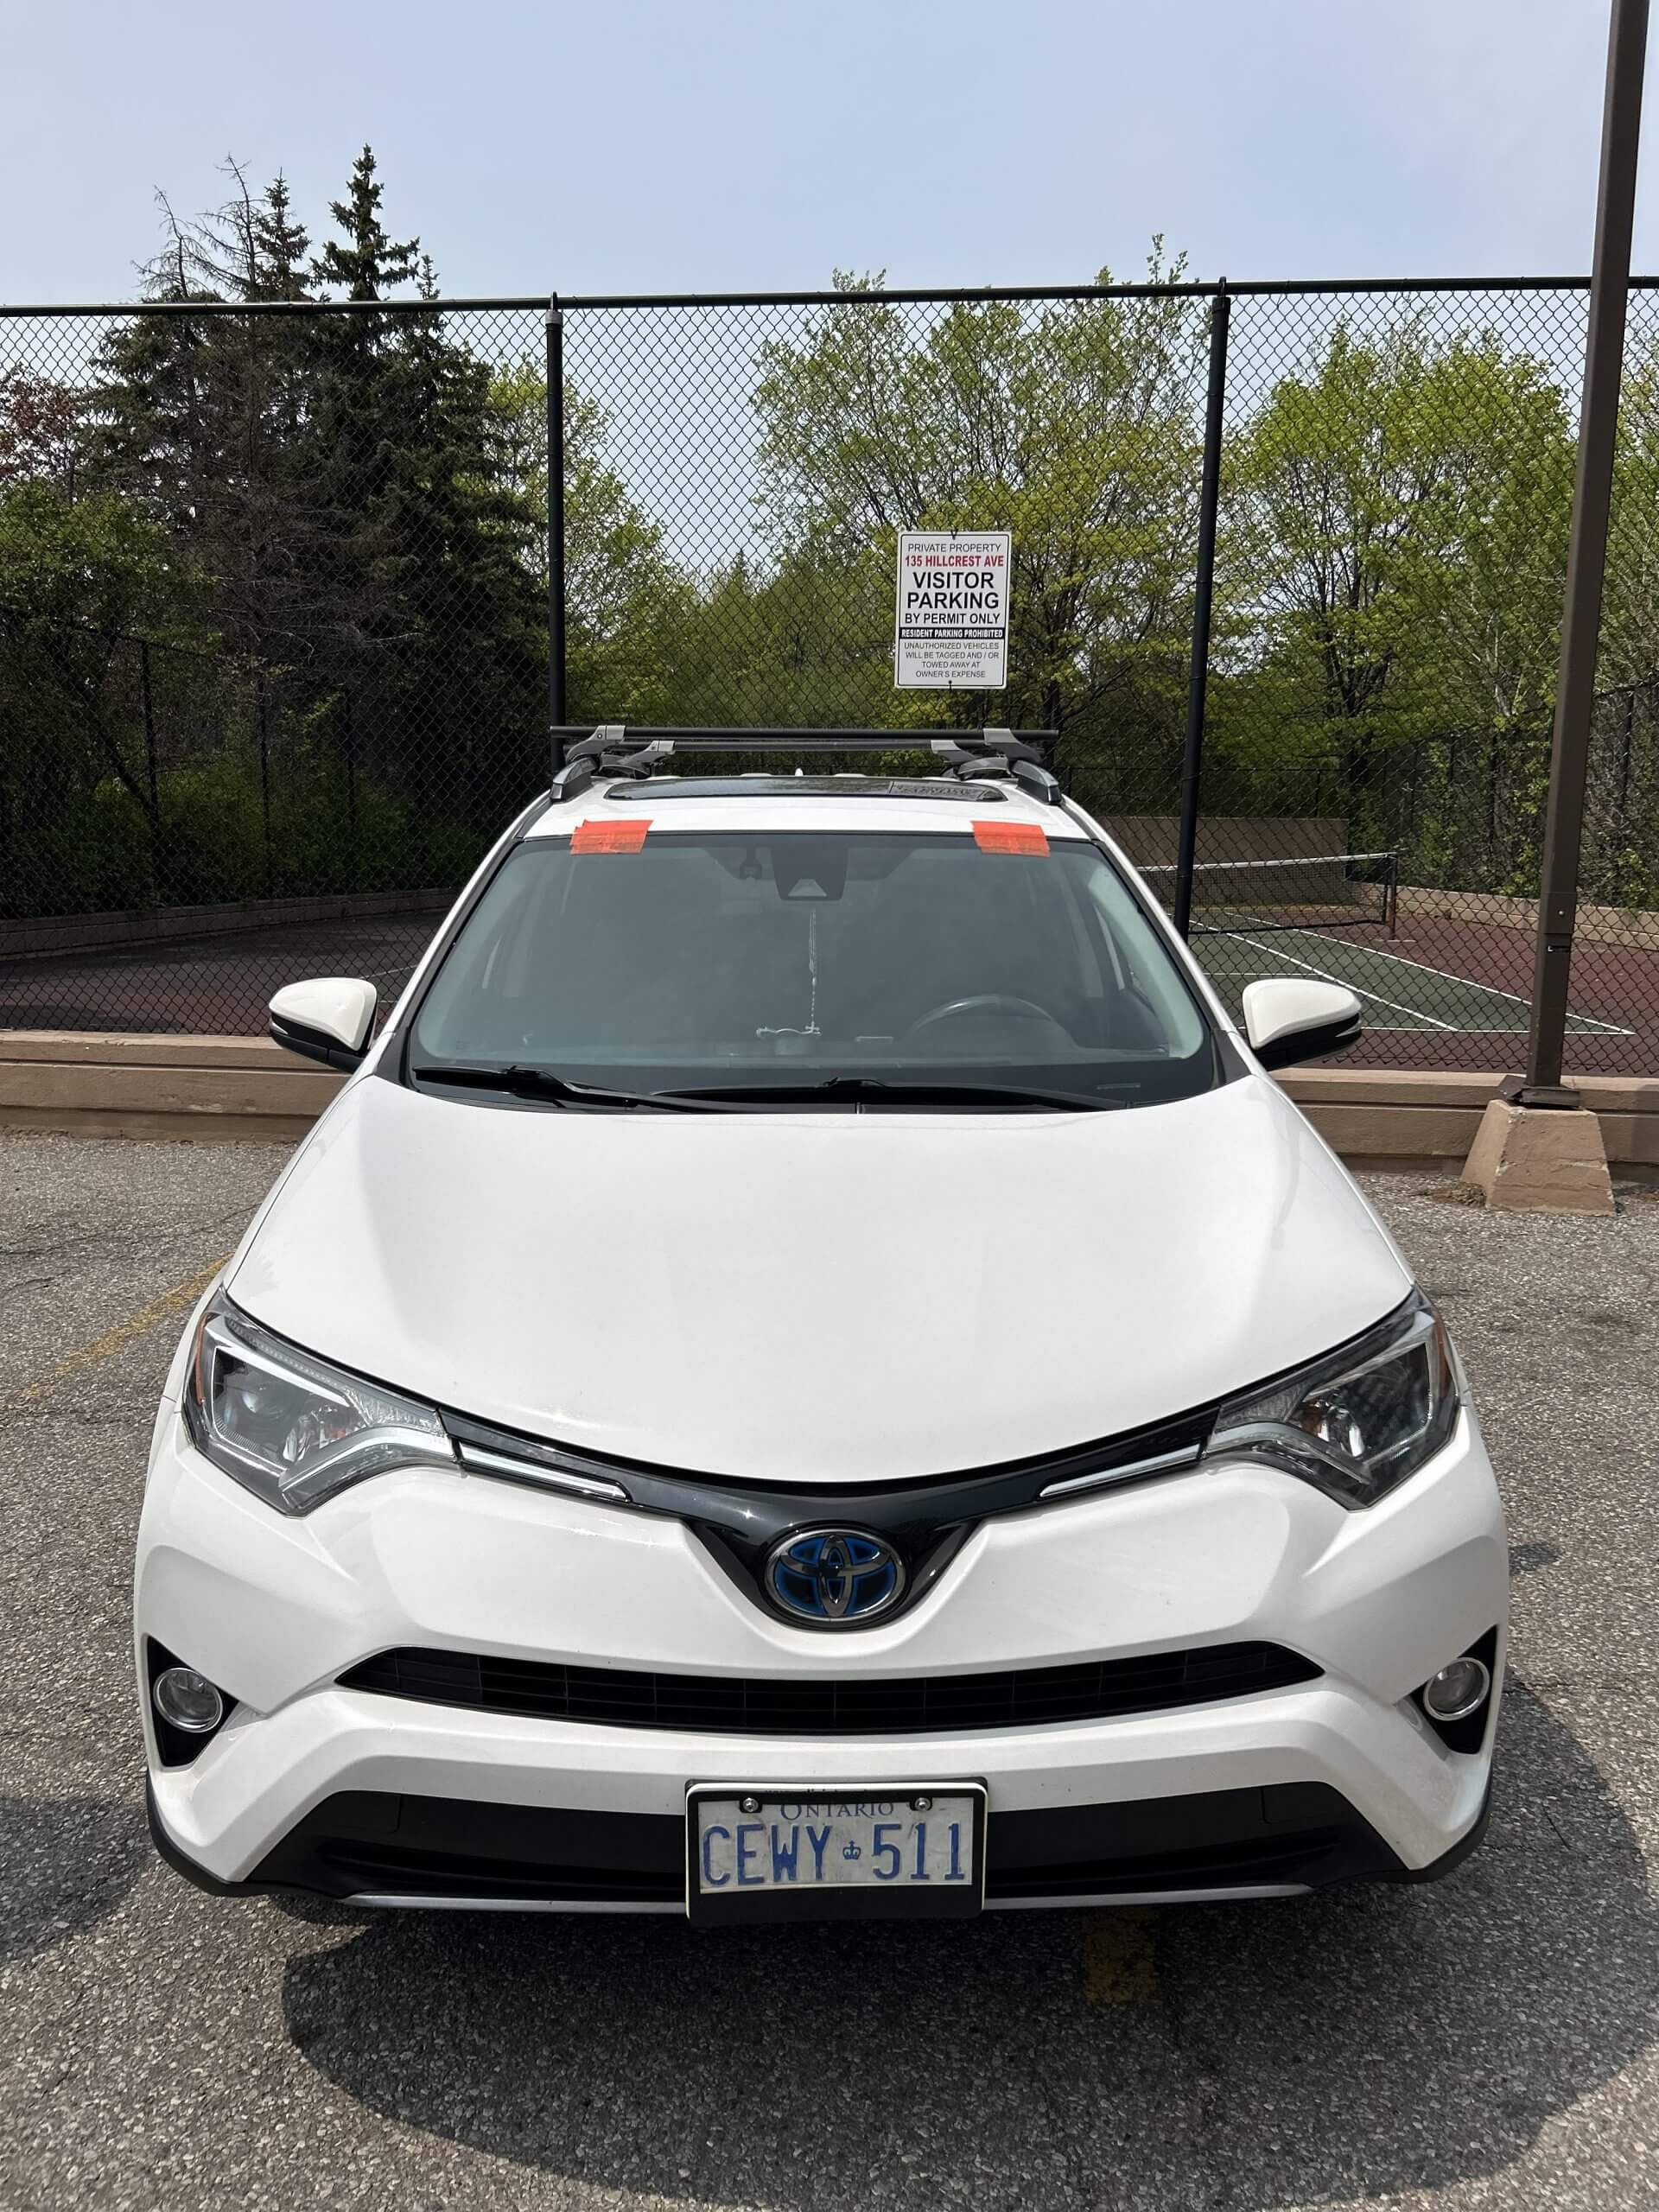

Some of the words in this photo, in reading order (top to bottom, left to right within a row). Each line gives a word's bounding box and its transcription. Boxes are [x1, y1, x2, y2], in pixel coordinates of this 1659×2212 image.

[908, 543, 946, 552] PRIVATE
[950, 543, 1001, 552] PROPERTY
[905, 555, 922, 567] 135
[926, 555, 981, 567] HILLCREST
[984, 555, 1004, 567] AVE
[912, 572, 995, 588] VISITOR
[907, 592, 999, 609] PARKING
[905, 613, 920, 624] BY
[923, 613, 966, 624] PERMIT
[969, 613, 1000, 624] ONLY
[902, 629, 933, 638] RESIDENT
[934, 629, 963, 638] PARKING
[964, 629, 1003, 638] PROHIBITED
[703, 1823, 830, 1885] CEWY
[871, 1822, 964, 1880] 511
